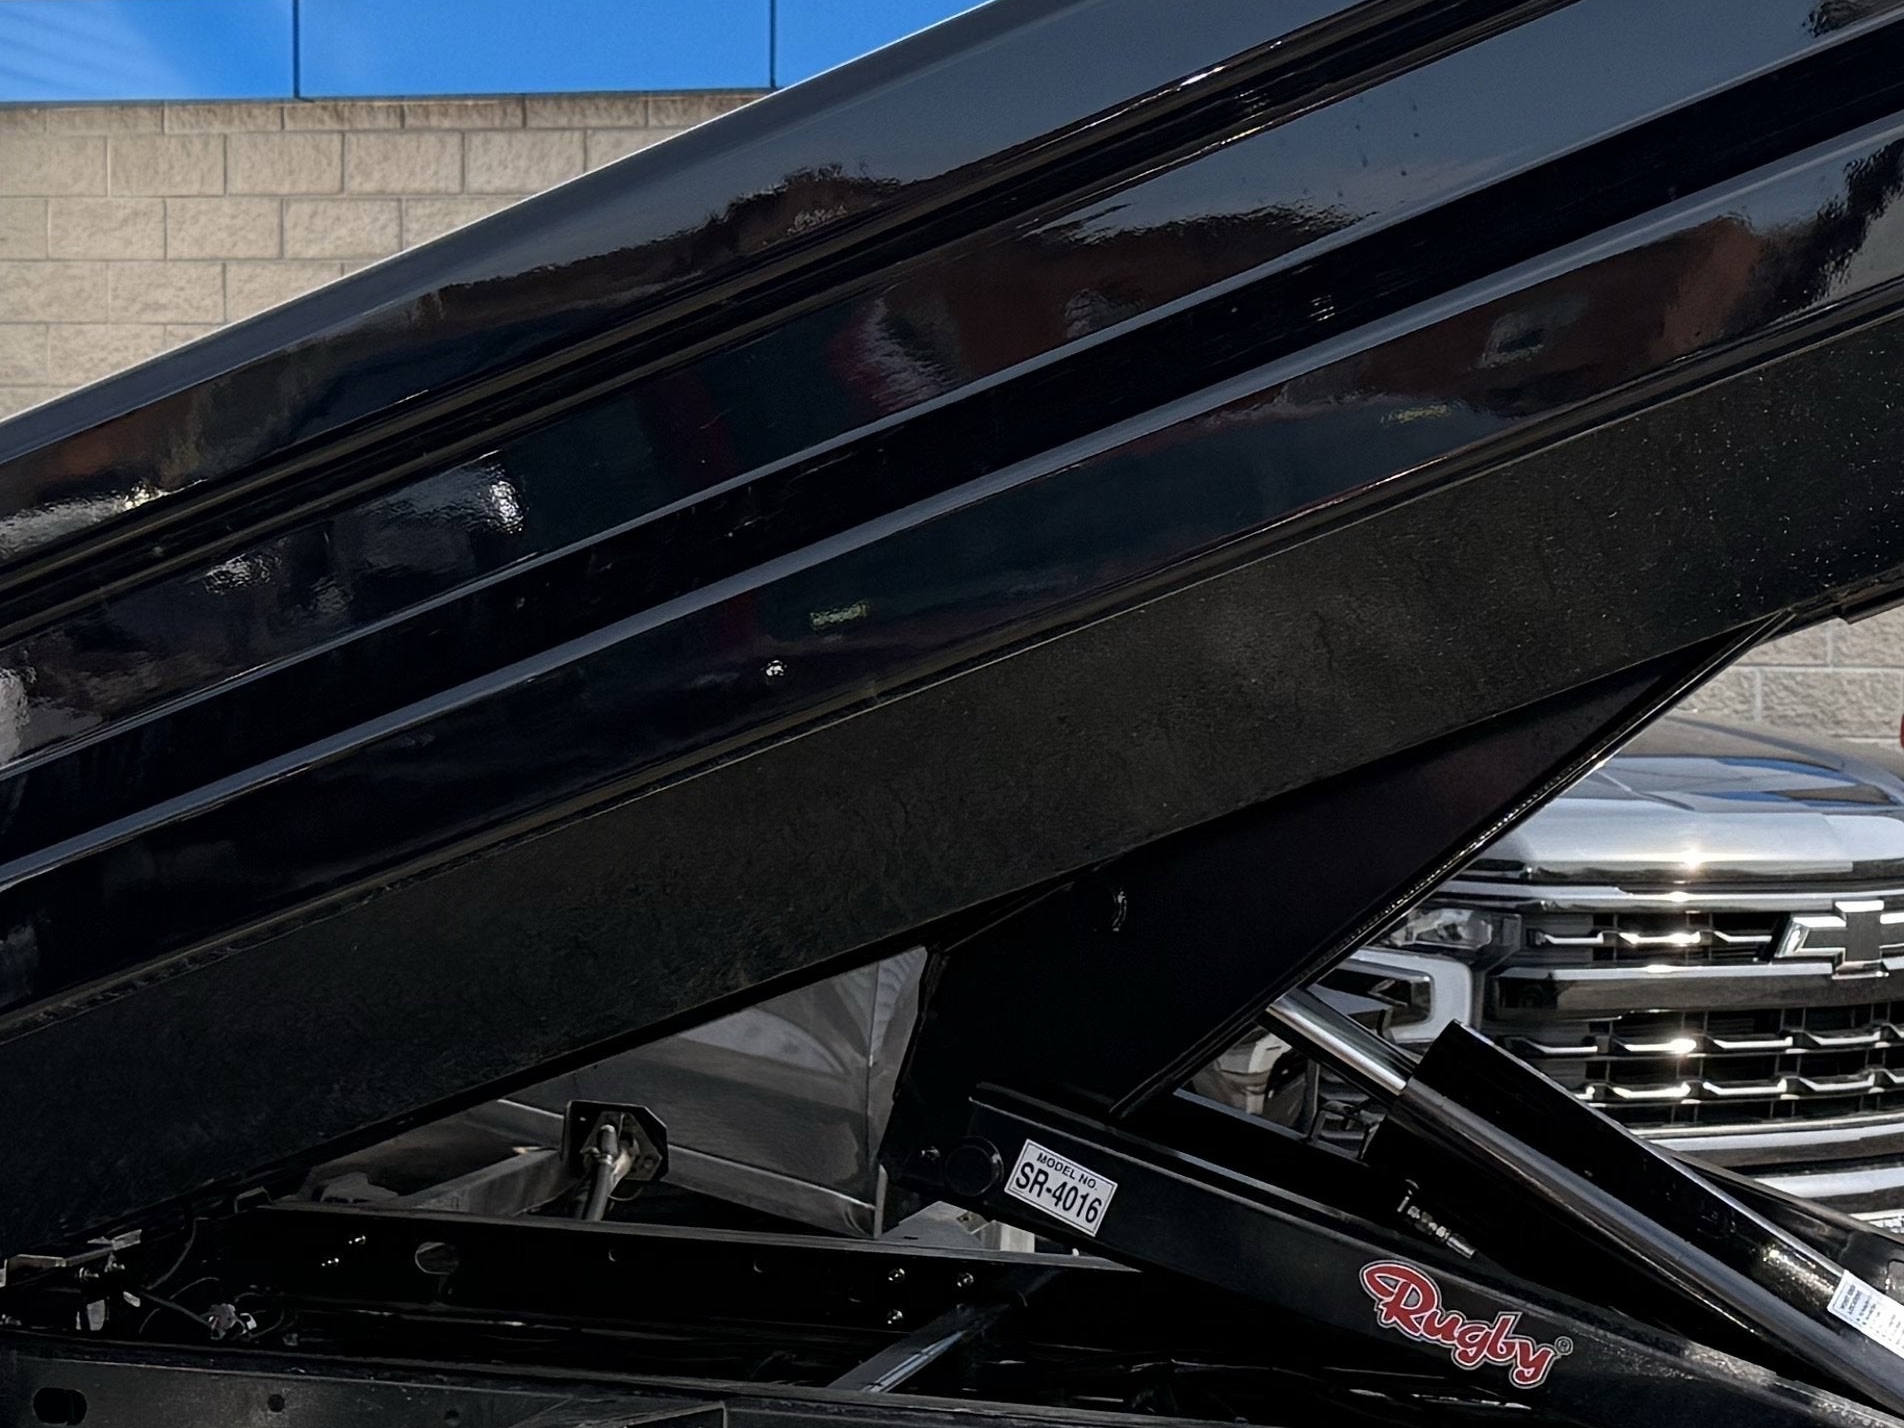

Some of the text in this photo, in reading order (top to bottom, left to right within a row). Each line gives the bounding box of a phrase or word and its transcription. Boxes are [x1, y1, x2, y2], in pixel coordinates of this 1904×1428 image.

[1015, 1162, 1103, 1224] SR-4016
[1036, 1152, 1098, 1191] MODEL NO.
